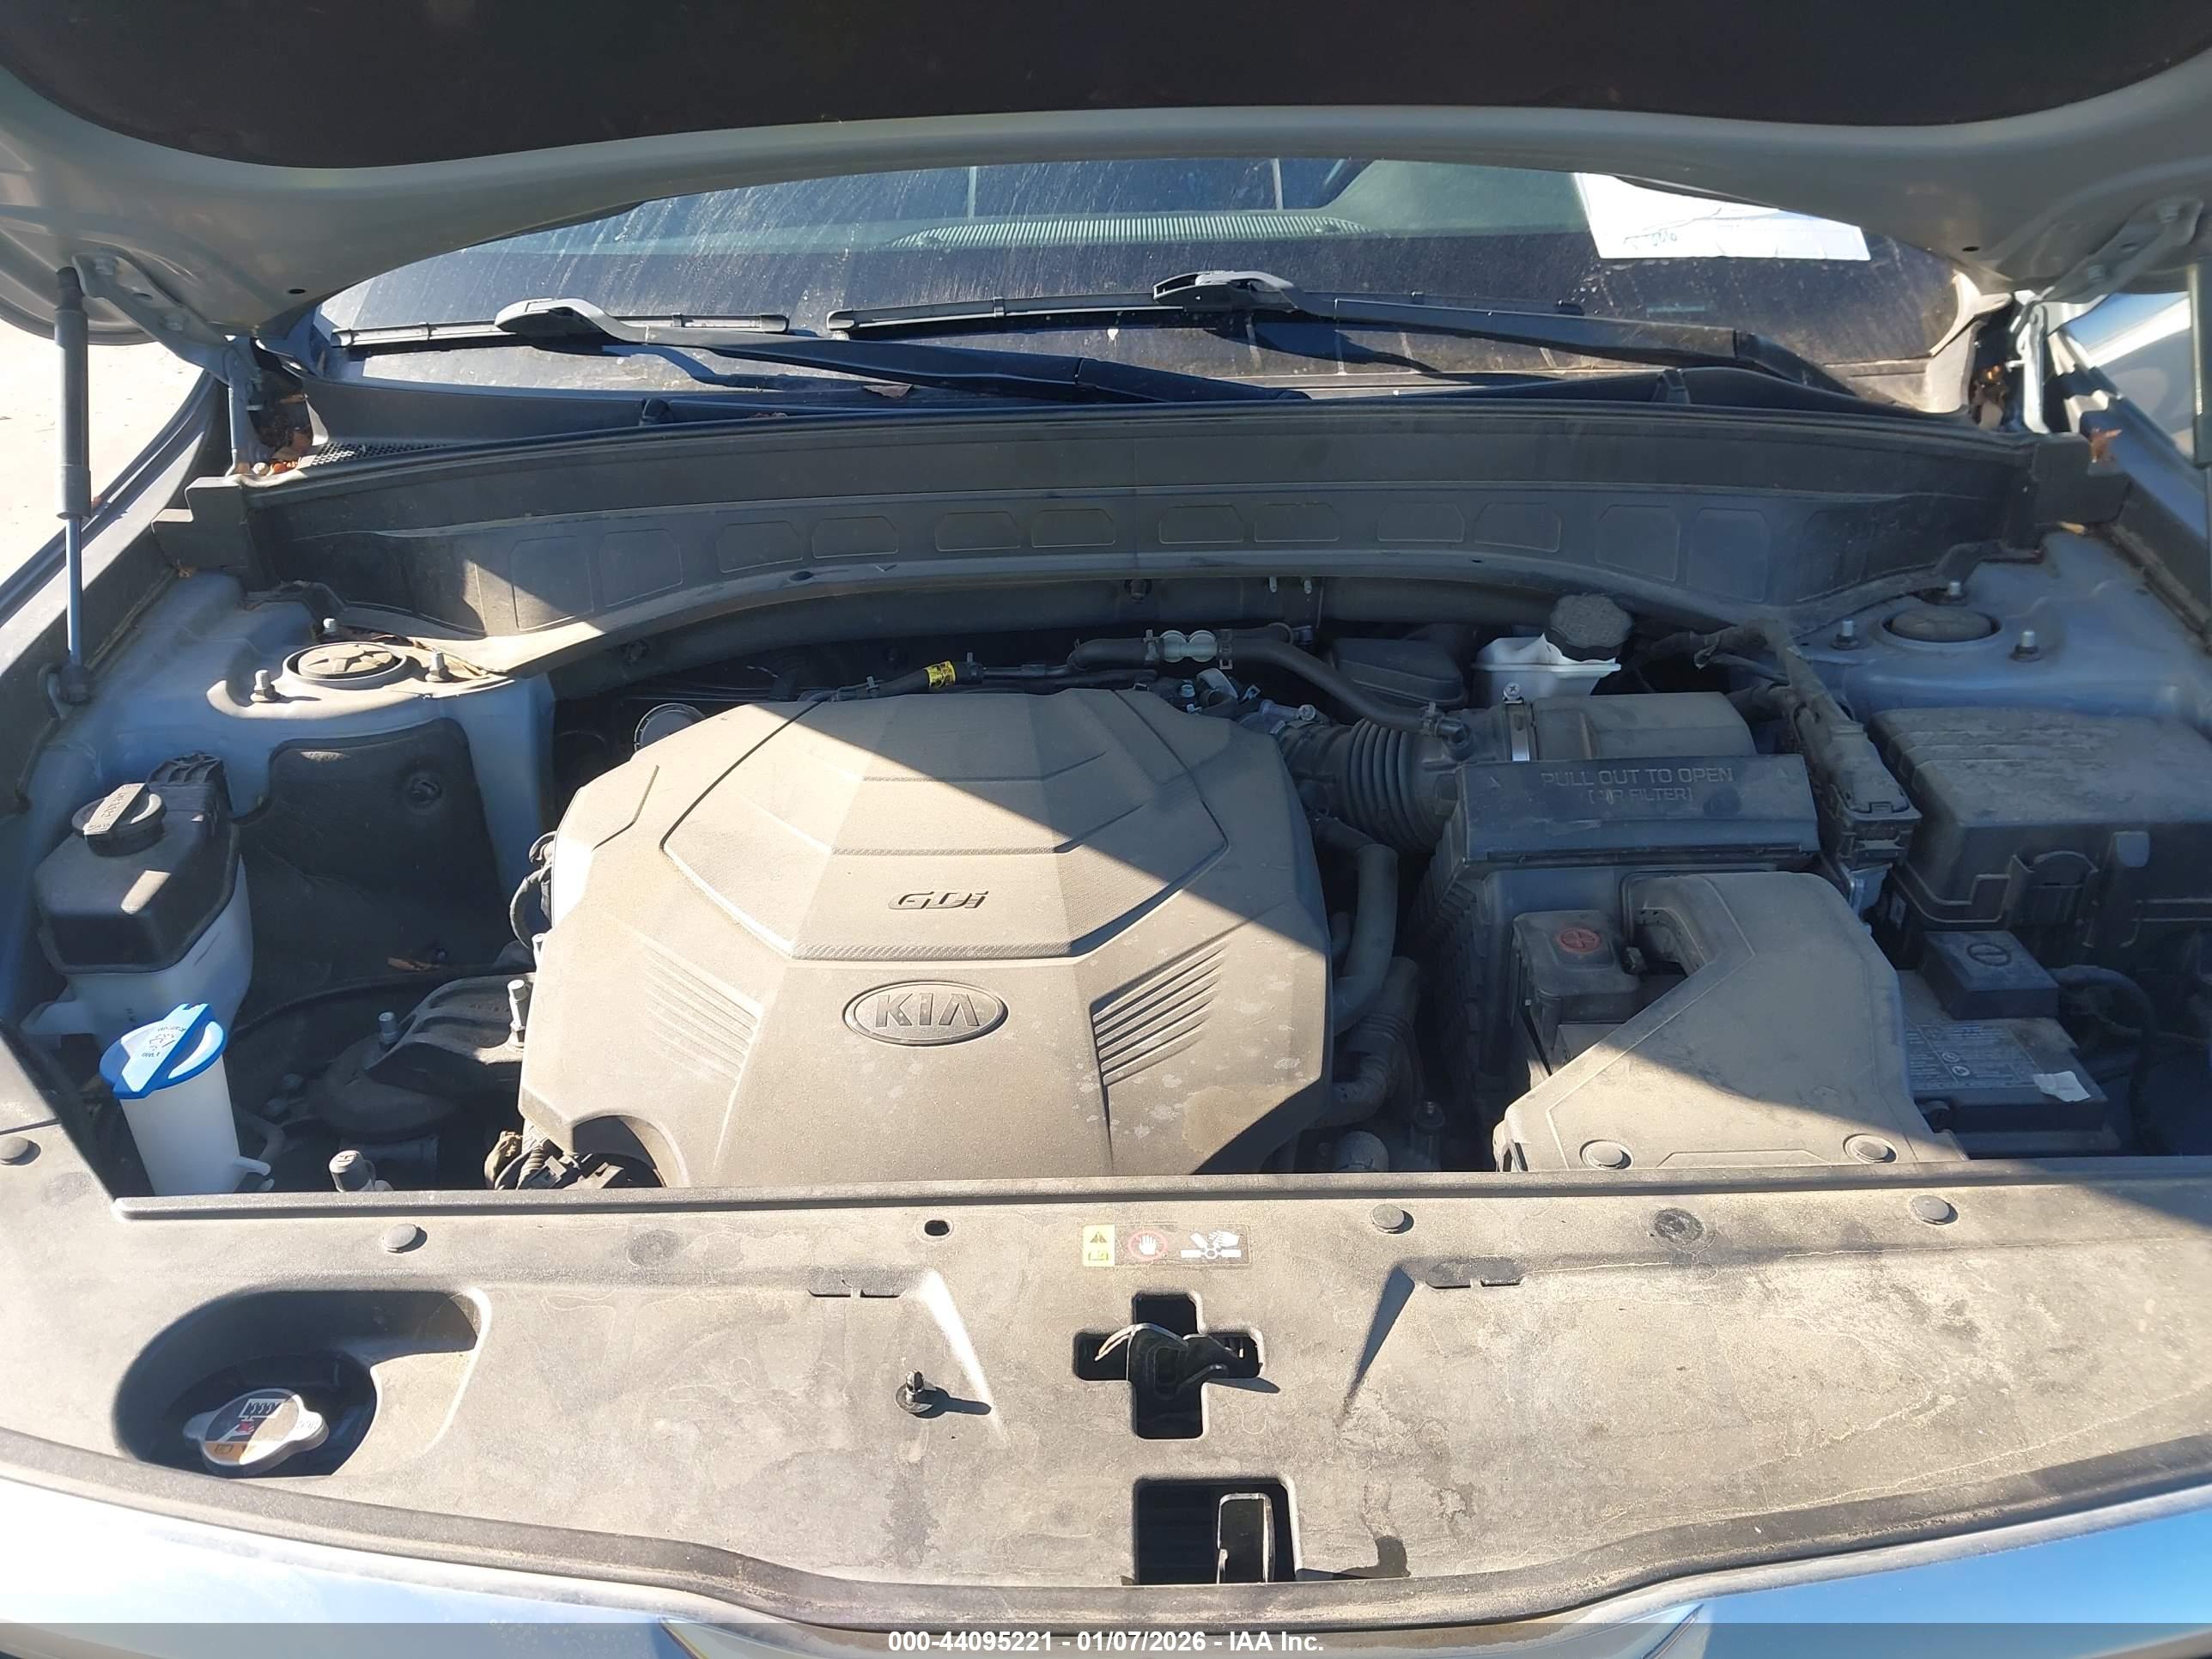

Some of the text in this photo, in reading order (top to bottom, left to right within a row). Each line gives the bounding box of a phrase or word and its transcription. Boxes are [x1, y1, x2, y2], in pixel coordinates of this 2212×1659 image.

[1541, 768, 1734, 787] PULL OUT TO OPEN
[875, 992, 980, 1027] KIA
